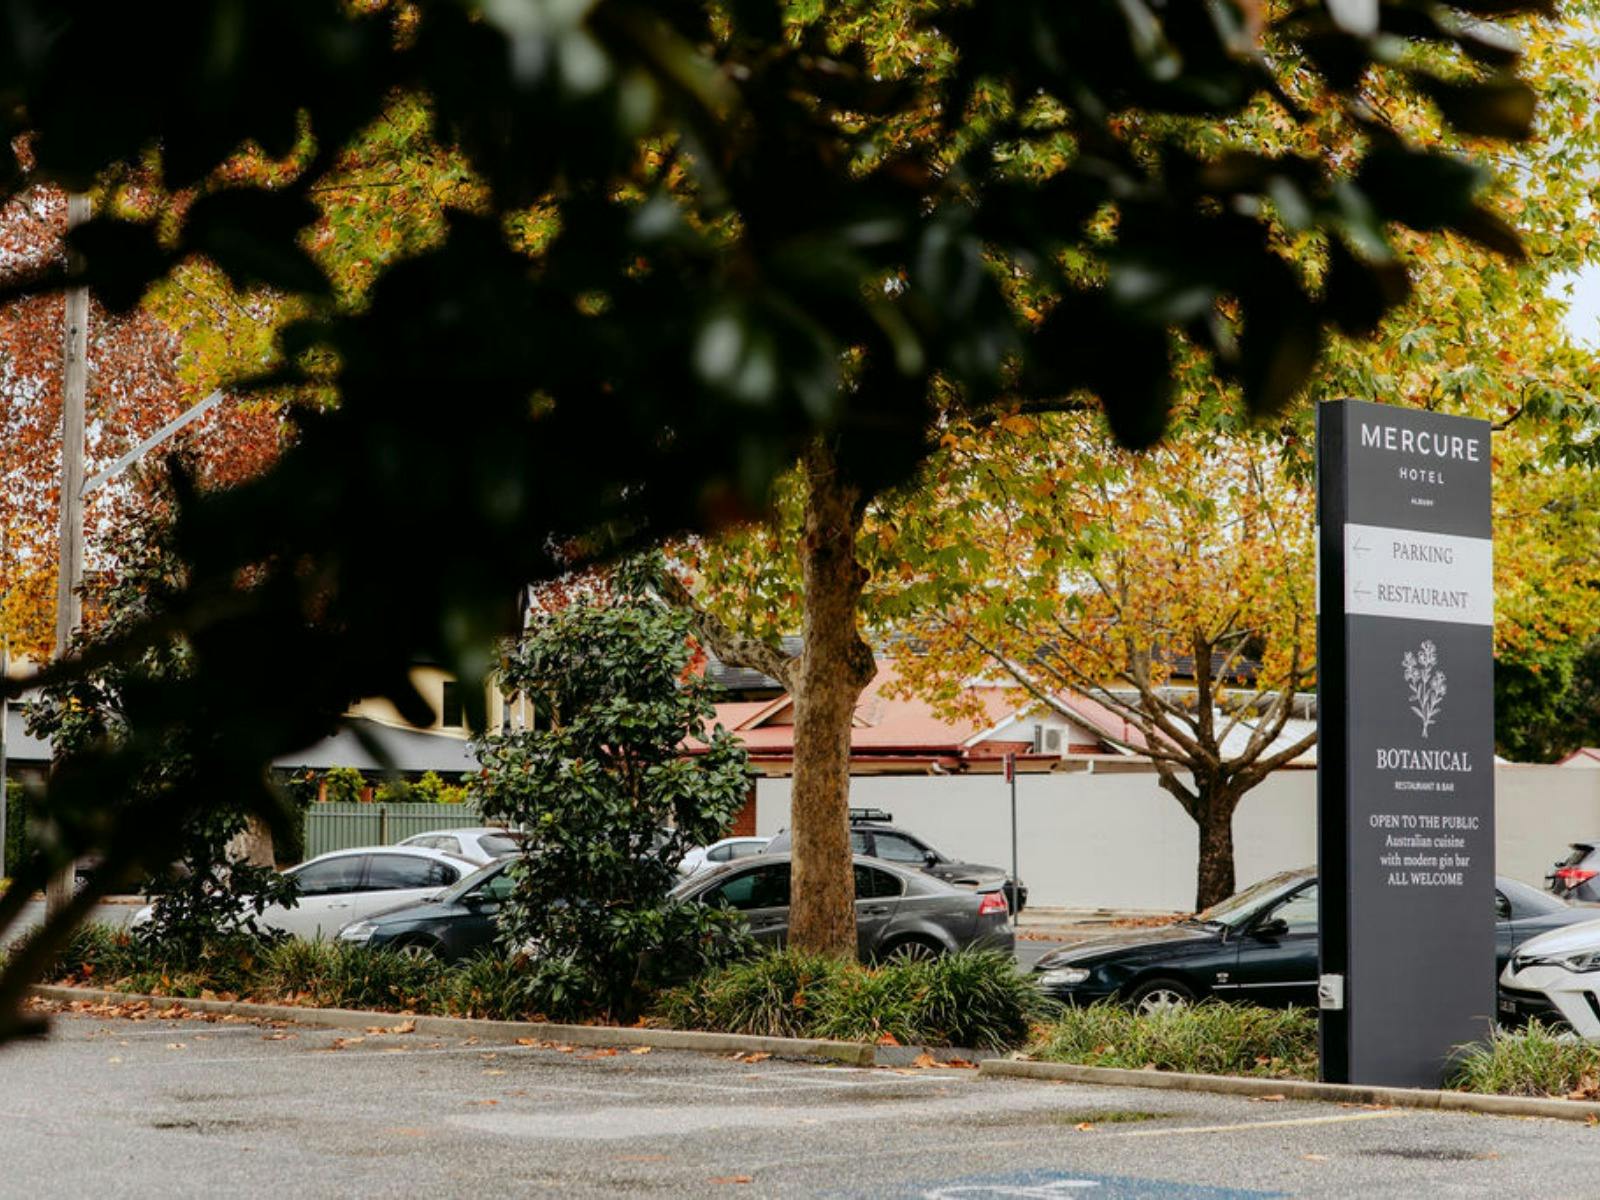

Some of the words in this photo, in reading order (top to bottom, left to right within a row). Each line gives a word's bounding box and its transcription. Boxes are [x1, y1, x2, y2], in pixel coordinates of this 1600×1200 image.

[1361, 423, 1480, 463] MERCURE
[1399, 467, 1444, 484] HOTEL
[1393, 542, 1454, 564] PARKING
[1377, 583, 1469, 608] RESTAURANT
[1376, 748, 1472, 772] BOTANICAL
[1395, 781, 1434, 791] RESTAURANT
[1442, 783, 1454, 792] BAR
[1370, 815, 1400, 828] OPEN
[1402, 815, 1417, 828] TO
[1419, 816, 1440, 829] THE
[1442, 817, 1479, 830] PUBLIC
[1385, 834, 1432, 848] Australian
[1434, 835, 1465, 848] cuisine
[1380, 852, 1402, 866] with
[1404, 853, 1437, 867] modern
[1439, 854, 1453, 869] gin
[1455, 853, 1470, 867] bar
[1388, 873, 1408, 885] ALL
[1411, 873, 1463, 886] WELCOME
